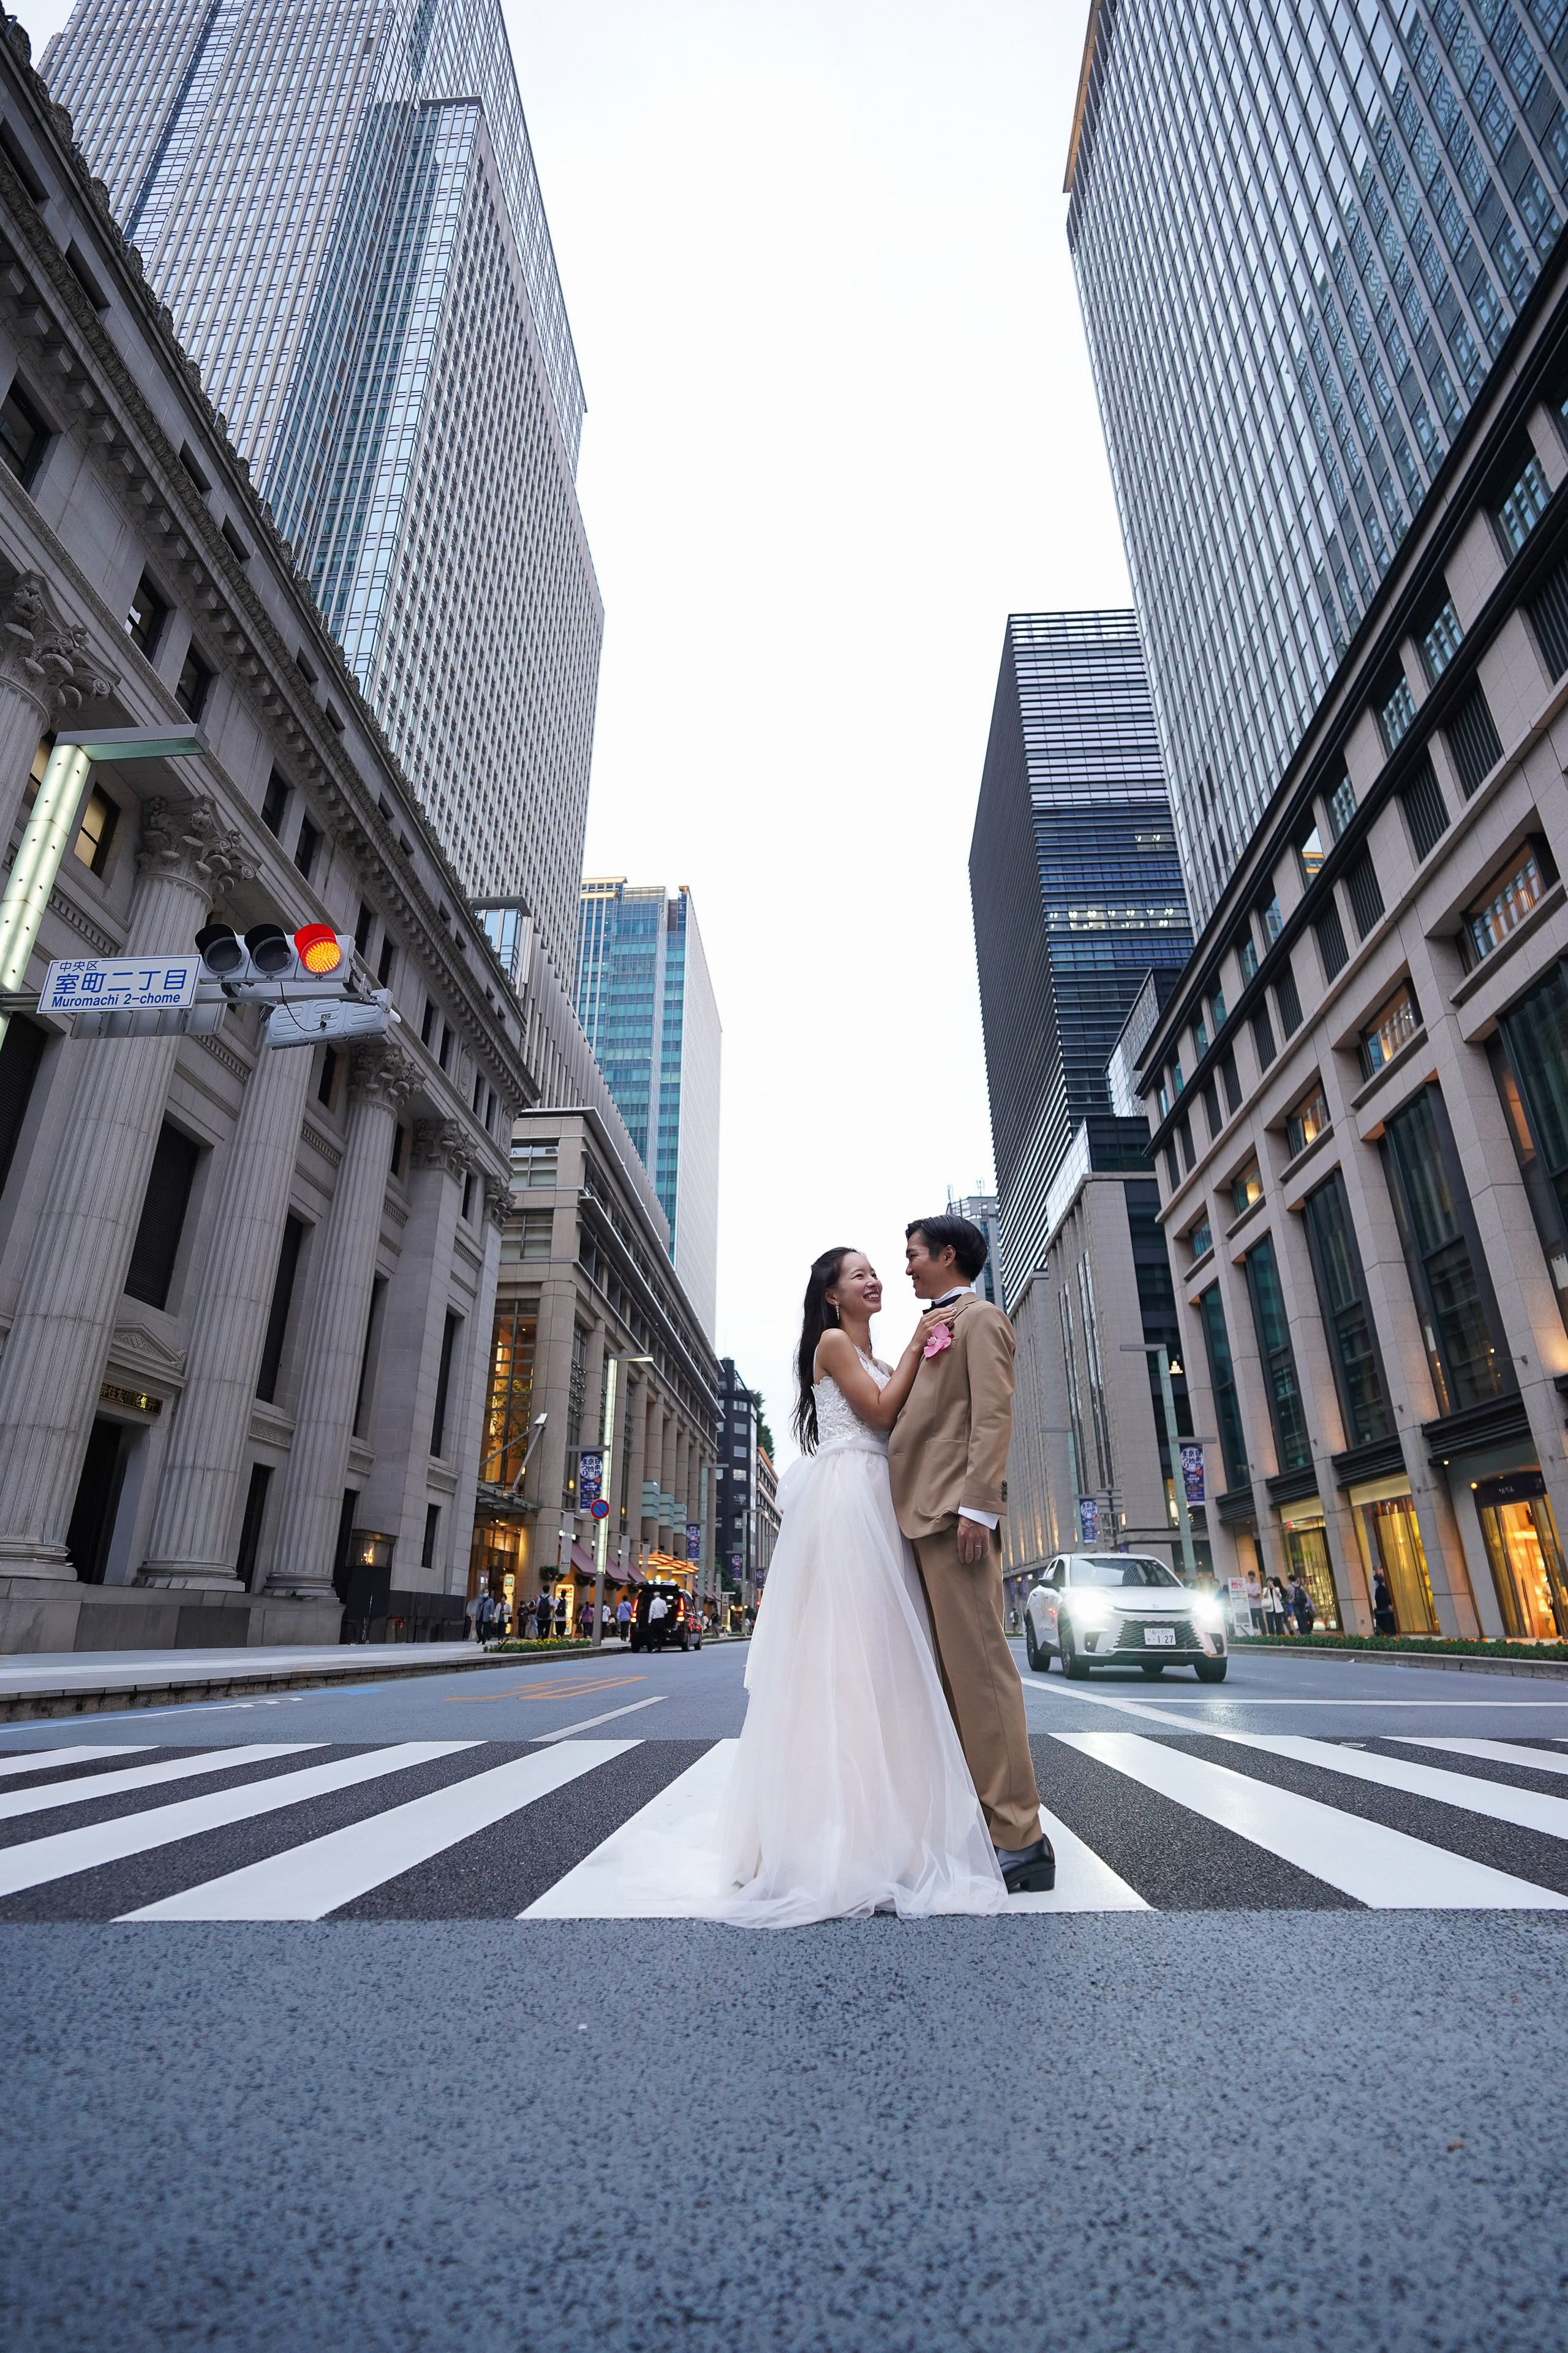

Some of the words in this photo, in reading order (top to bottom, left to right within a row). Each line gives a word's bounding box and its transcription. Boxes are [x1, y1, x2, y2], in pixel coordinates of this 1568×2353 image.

[59, 961, 99, 972] 中央区
[53, 969, 187, 995] 室町二丁目
[51, 994, 119, 1008] Muromachi
[123, 993, 181, 1005] 2-chome
